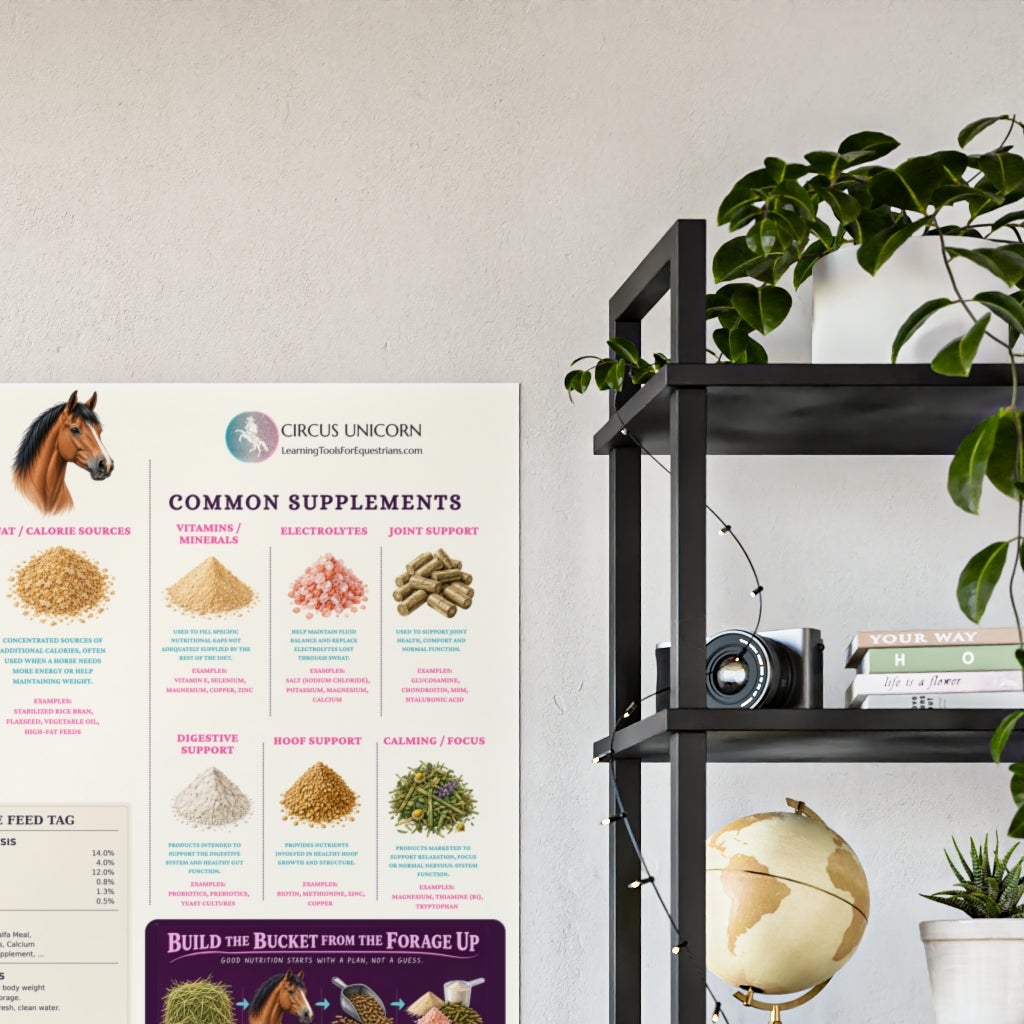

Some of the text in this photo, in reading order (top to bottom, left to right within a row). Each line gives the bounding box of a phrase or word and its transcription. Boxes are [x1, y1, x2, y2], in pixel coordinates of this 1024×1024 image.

[281, 424, 421, 437] CIRCUS UNICORN
[282, 446, 423, 456] LearningToolsForEquestrians.com
[169, 494, 461, 510] COMMON SUPPLEMENTS
[26, 527, 76, 535] CALORIE
[78, 527, 131, 535] SOURCES
[176, 524, 234, 532] VITAMINS
[281, 527, 368, 535] ELECTROLYTES
[388, 527, 479, 537] JOINT SUPPORT
[180, 536, 238, 544] MINERALS
[870, 632, 978, 644] YOUR WAY
[884, 676, 901, 691] life
[927, 675, 962, 690] flower
[178, 734, 238, 742] DIGESTIVE
[274, 737, 362, 745] HOOF SUPPORT
[384, 737, 437, 745] CALMING
[448, 737, 485, 745] FOCUS
[181, 746, 234, 754] SUPPORT
[8, 816, 43, 825] FEED
[48, 815, 74, 825] TAG
